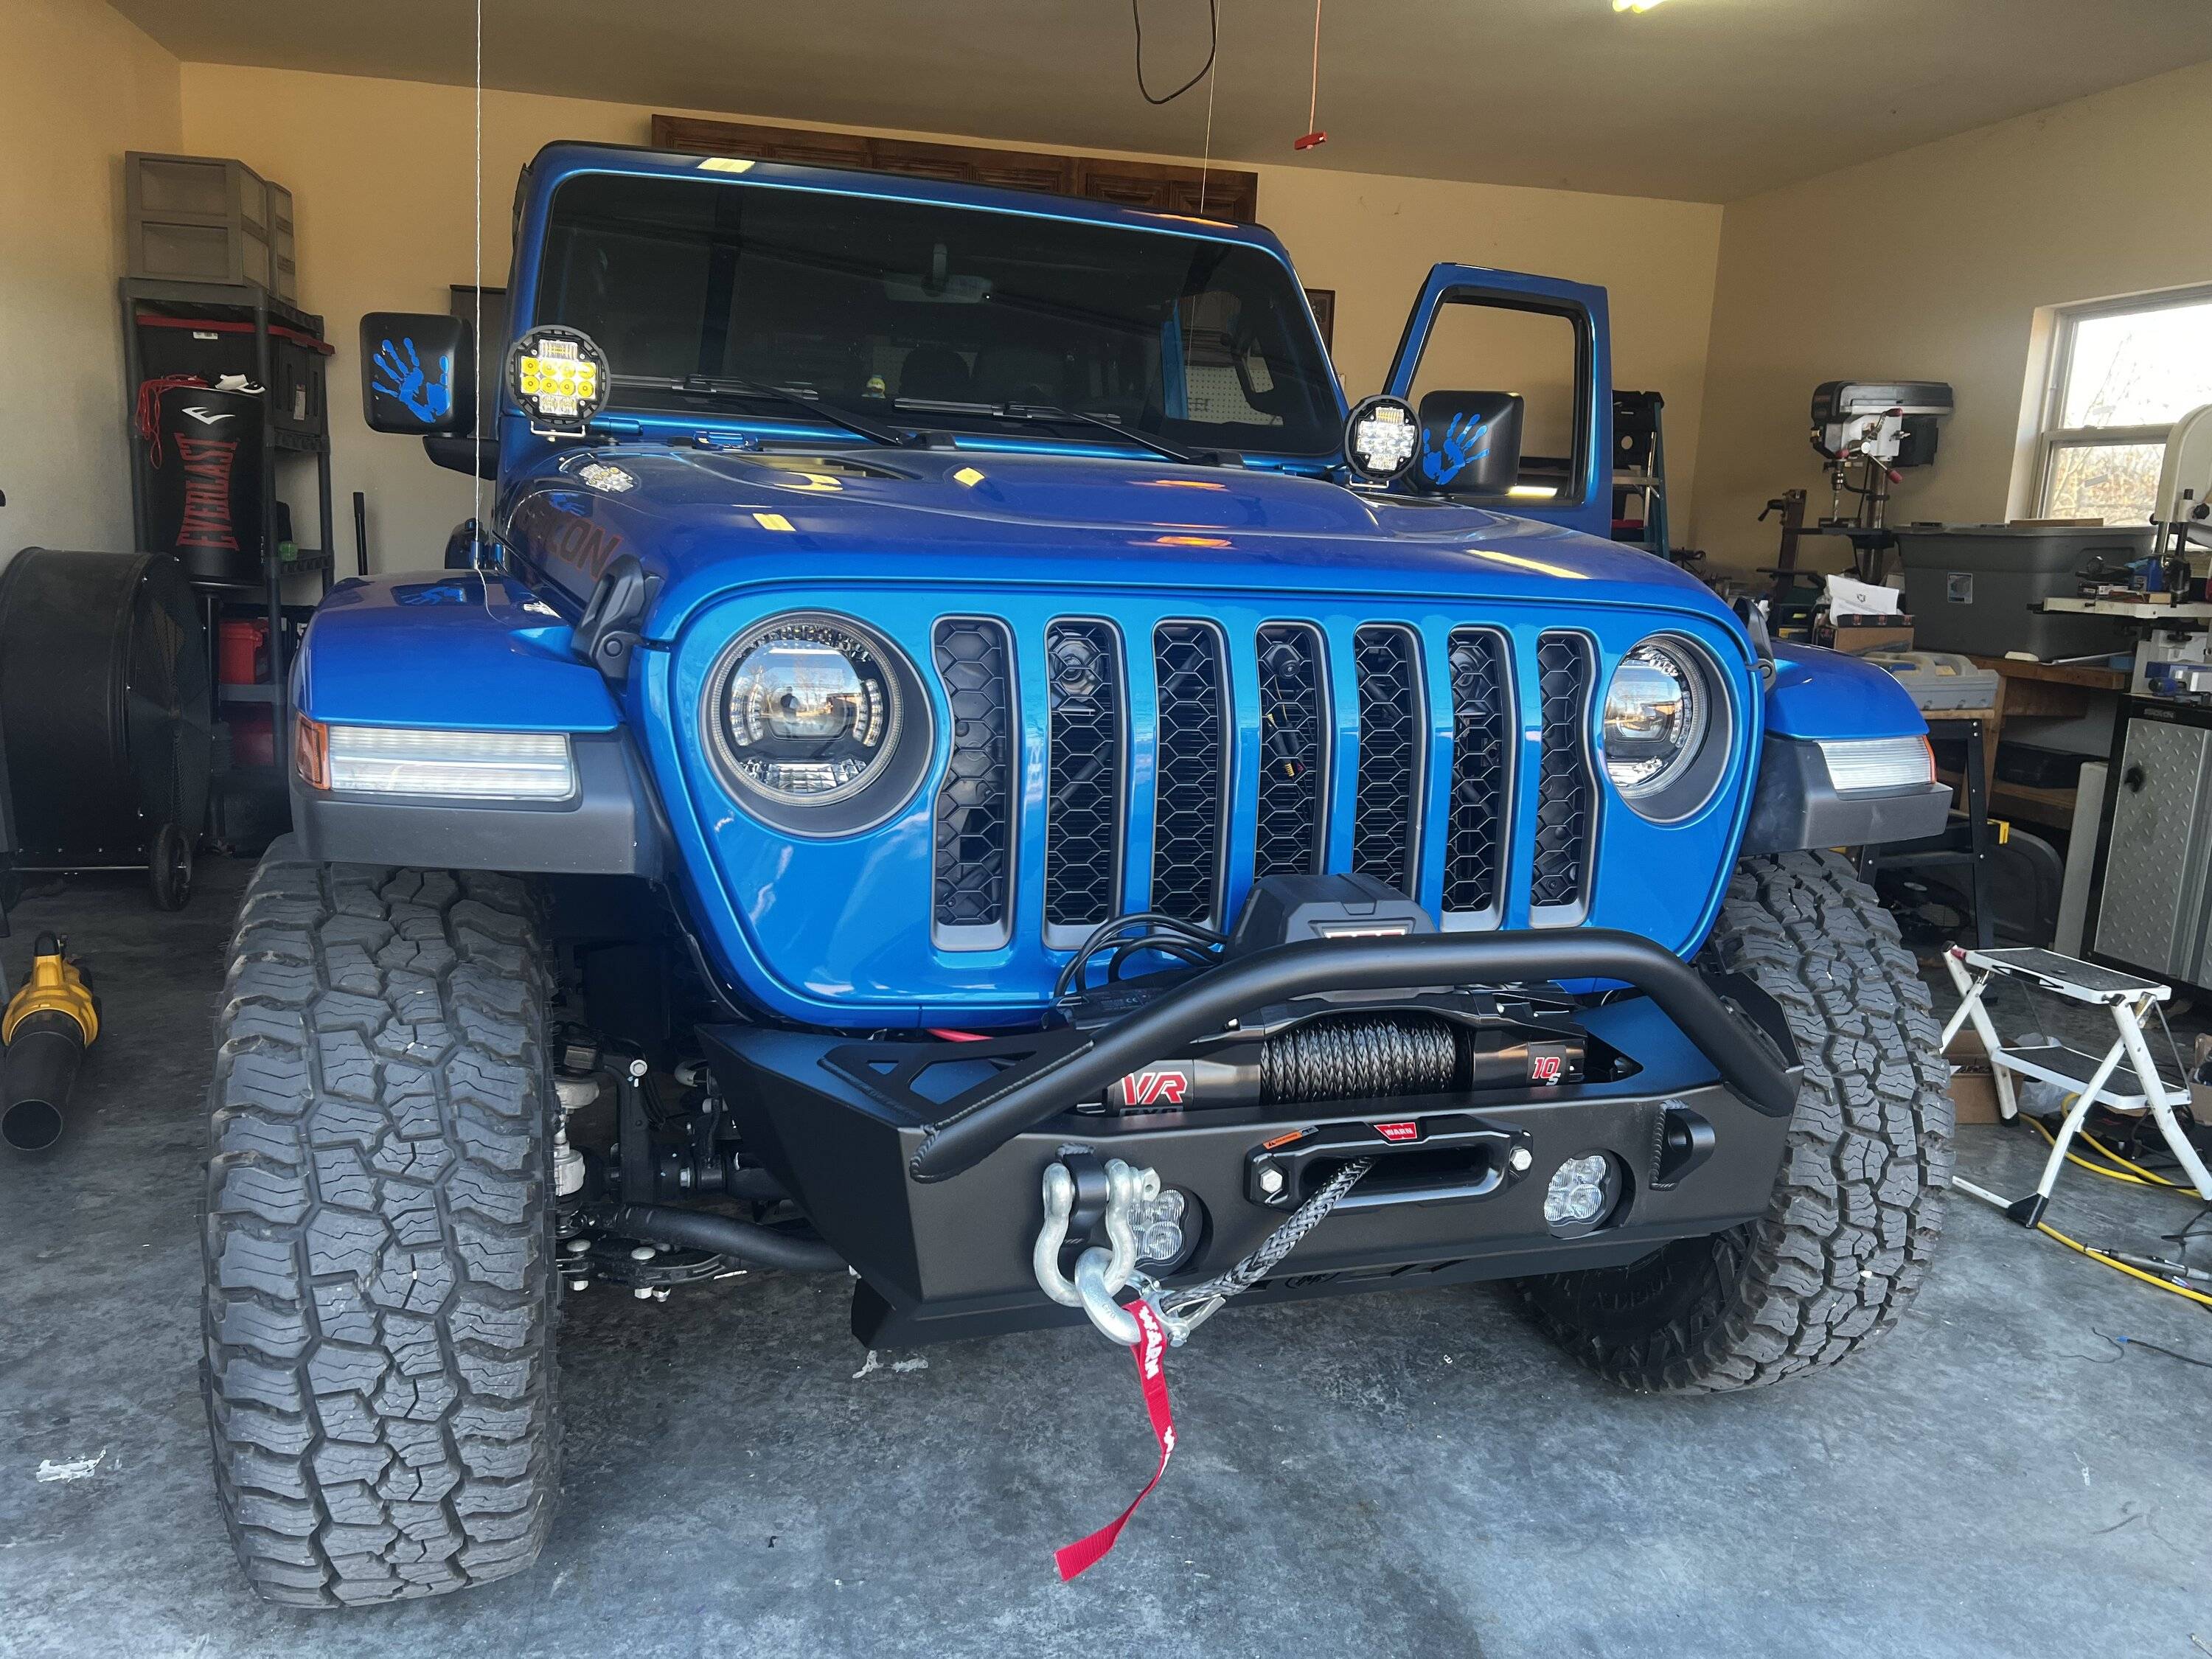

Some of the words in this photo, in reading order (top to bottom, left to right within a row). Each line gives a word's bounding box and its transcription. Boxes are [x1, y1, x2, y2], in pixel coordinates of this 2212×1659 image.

[174, 432, 240, 552] EVERLAST
[1121, 1071, 1188, 1105] VR
[1138, 1305, 1163, 1380] WARN
